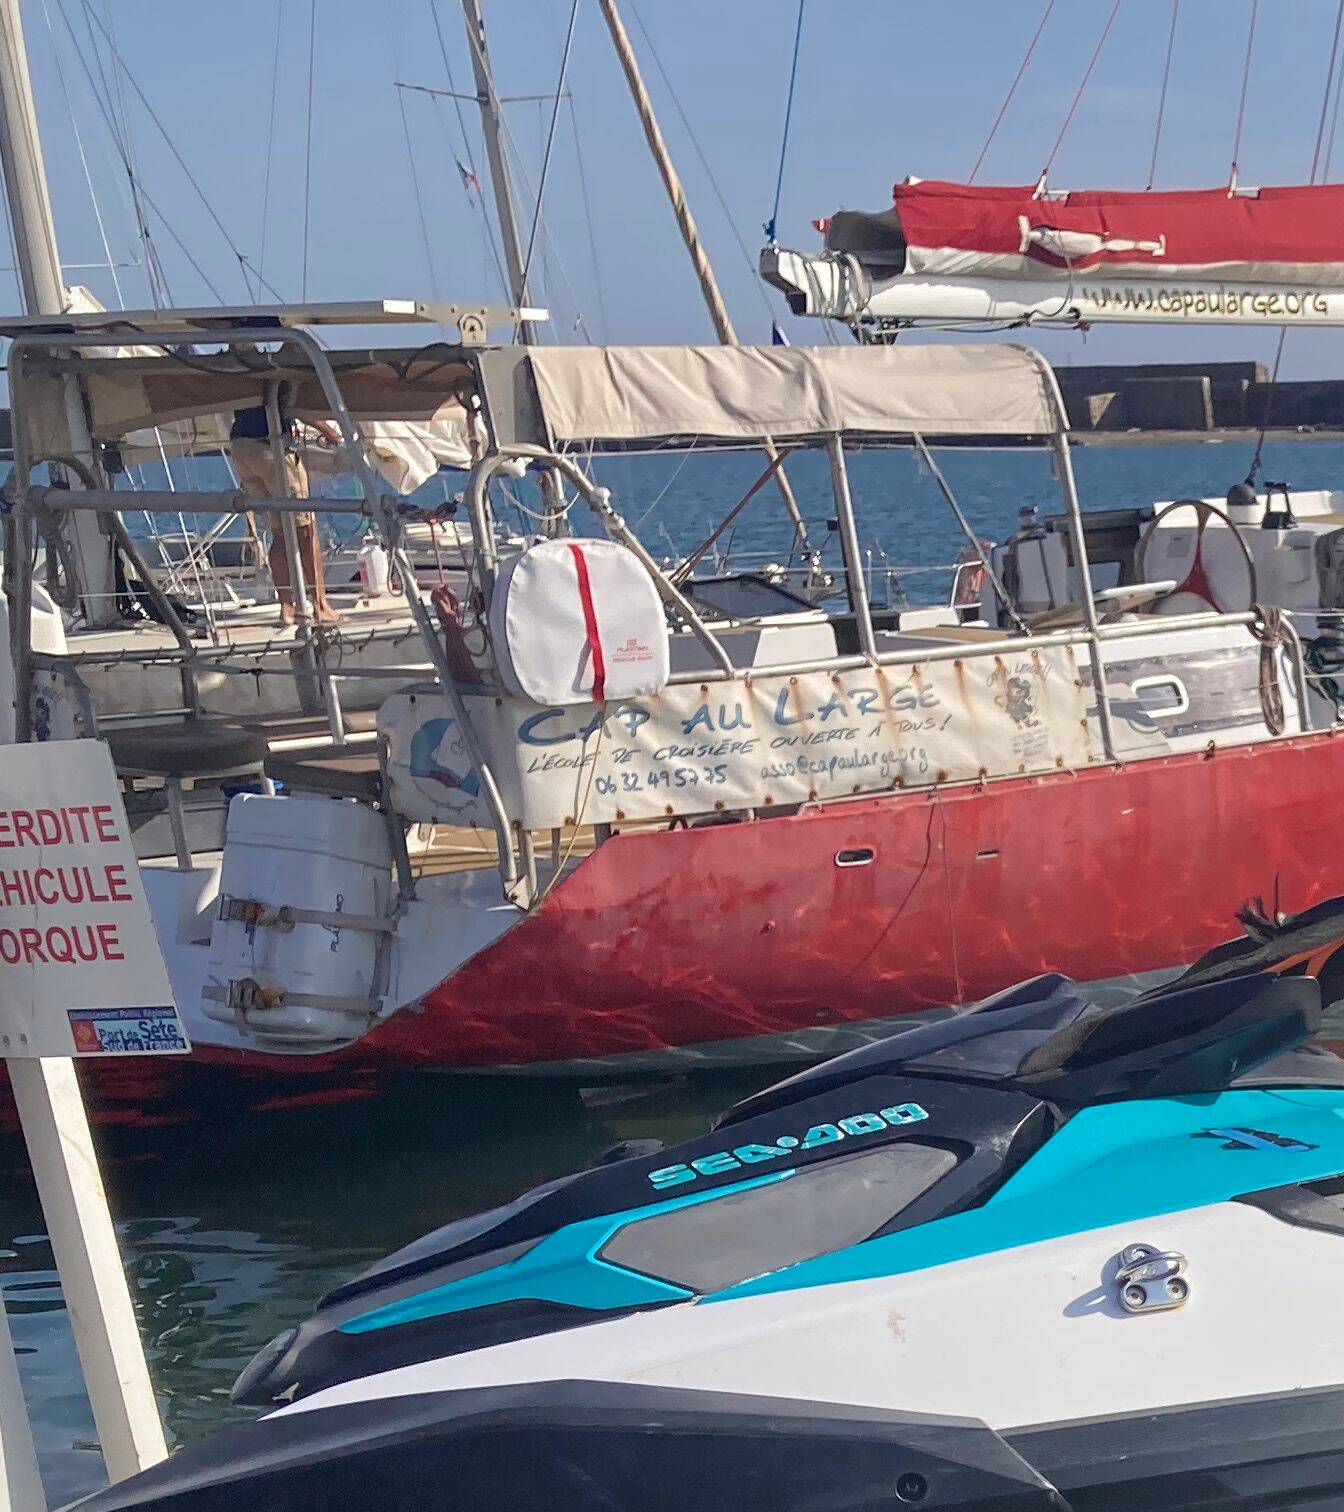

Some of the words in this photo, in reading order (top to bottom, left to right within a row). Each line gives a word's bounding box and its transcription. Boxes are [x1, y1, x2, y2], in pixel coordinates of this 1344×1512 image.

[517, 704, 651, 746] CAP
[681, 702, 753, 735] AU
[773, 682, 942, 726] LARGE
[612, 747, 641, 765] DE
[770, 727, 860, 749] OUVERTE
[594, 775, 618, 795] 06
[621, 772, 643, 792] 32
[647, 770, 670, 789] 49
[0, 864, 133, 907] HICULE
